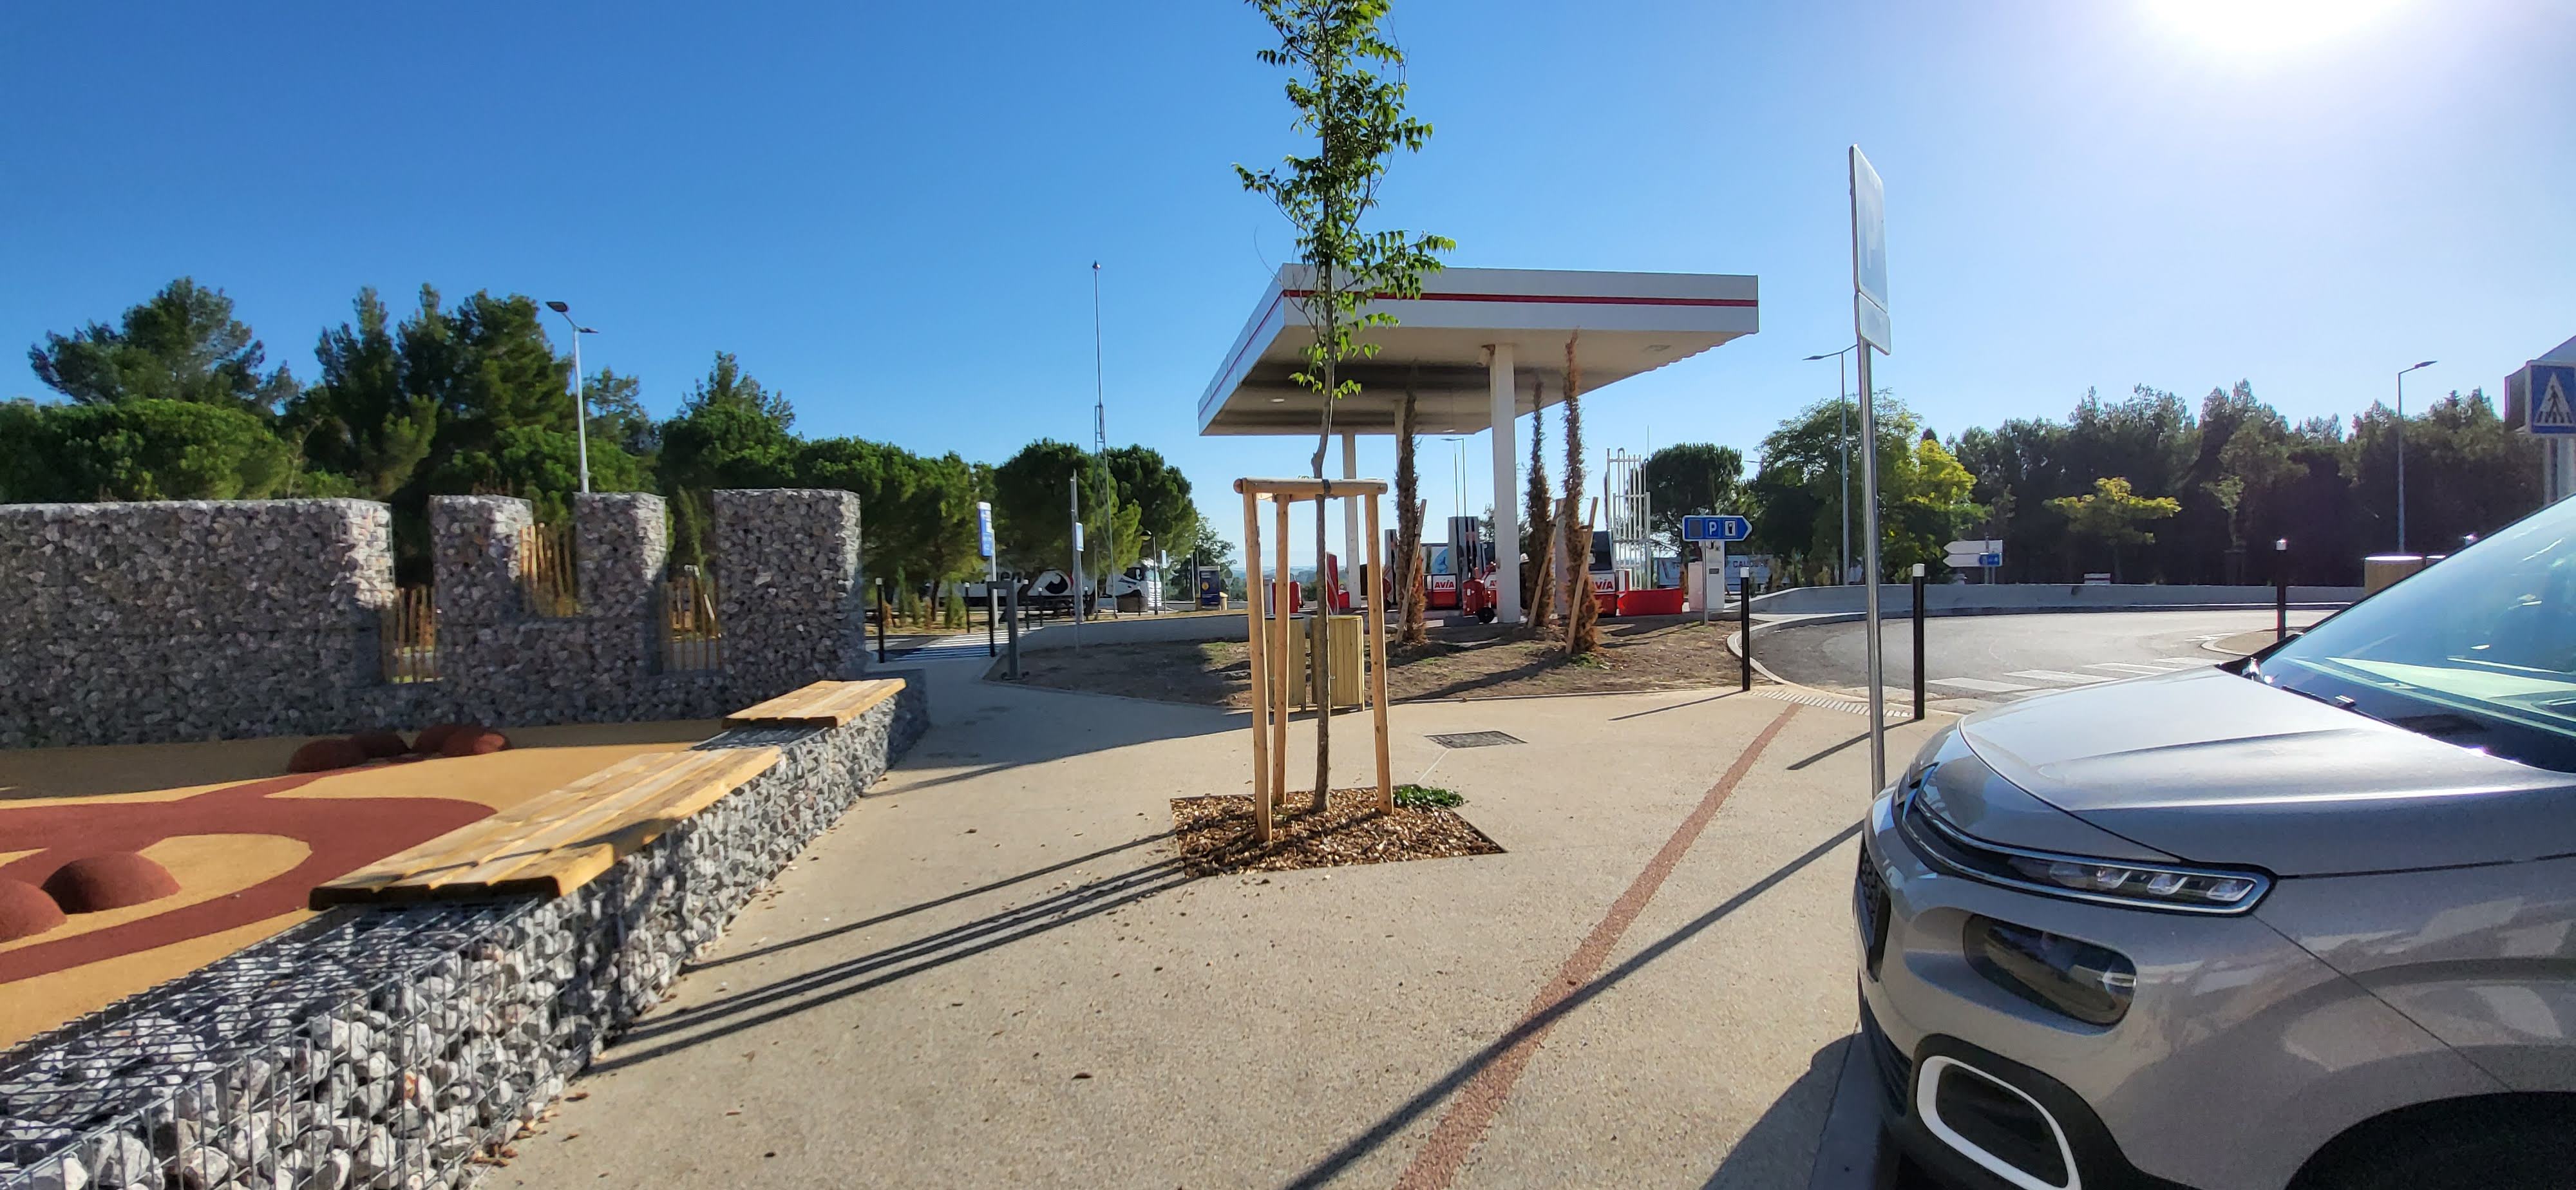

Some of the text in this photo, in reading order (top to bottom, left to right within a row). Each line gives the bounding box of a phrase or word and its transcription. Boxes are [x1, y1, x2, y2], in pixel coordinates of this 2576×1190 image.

[1709, 521, 1718, 536] P
[1434, 580, 1455, 589] AVIA
[1592, 581, 1614, 590] VIA
